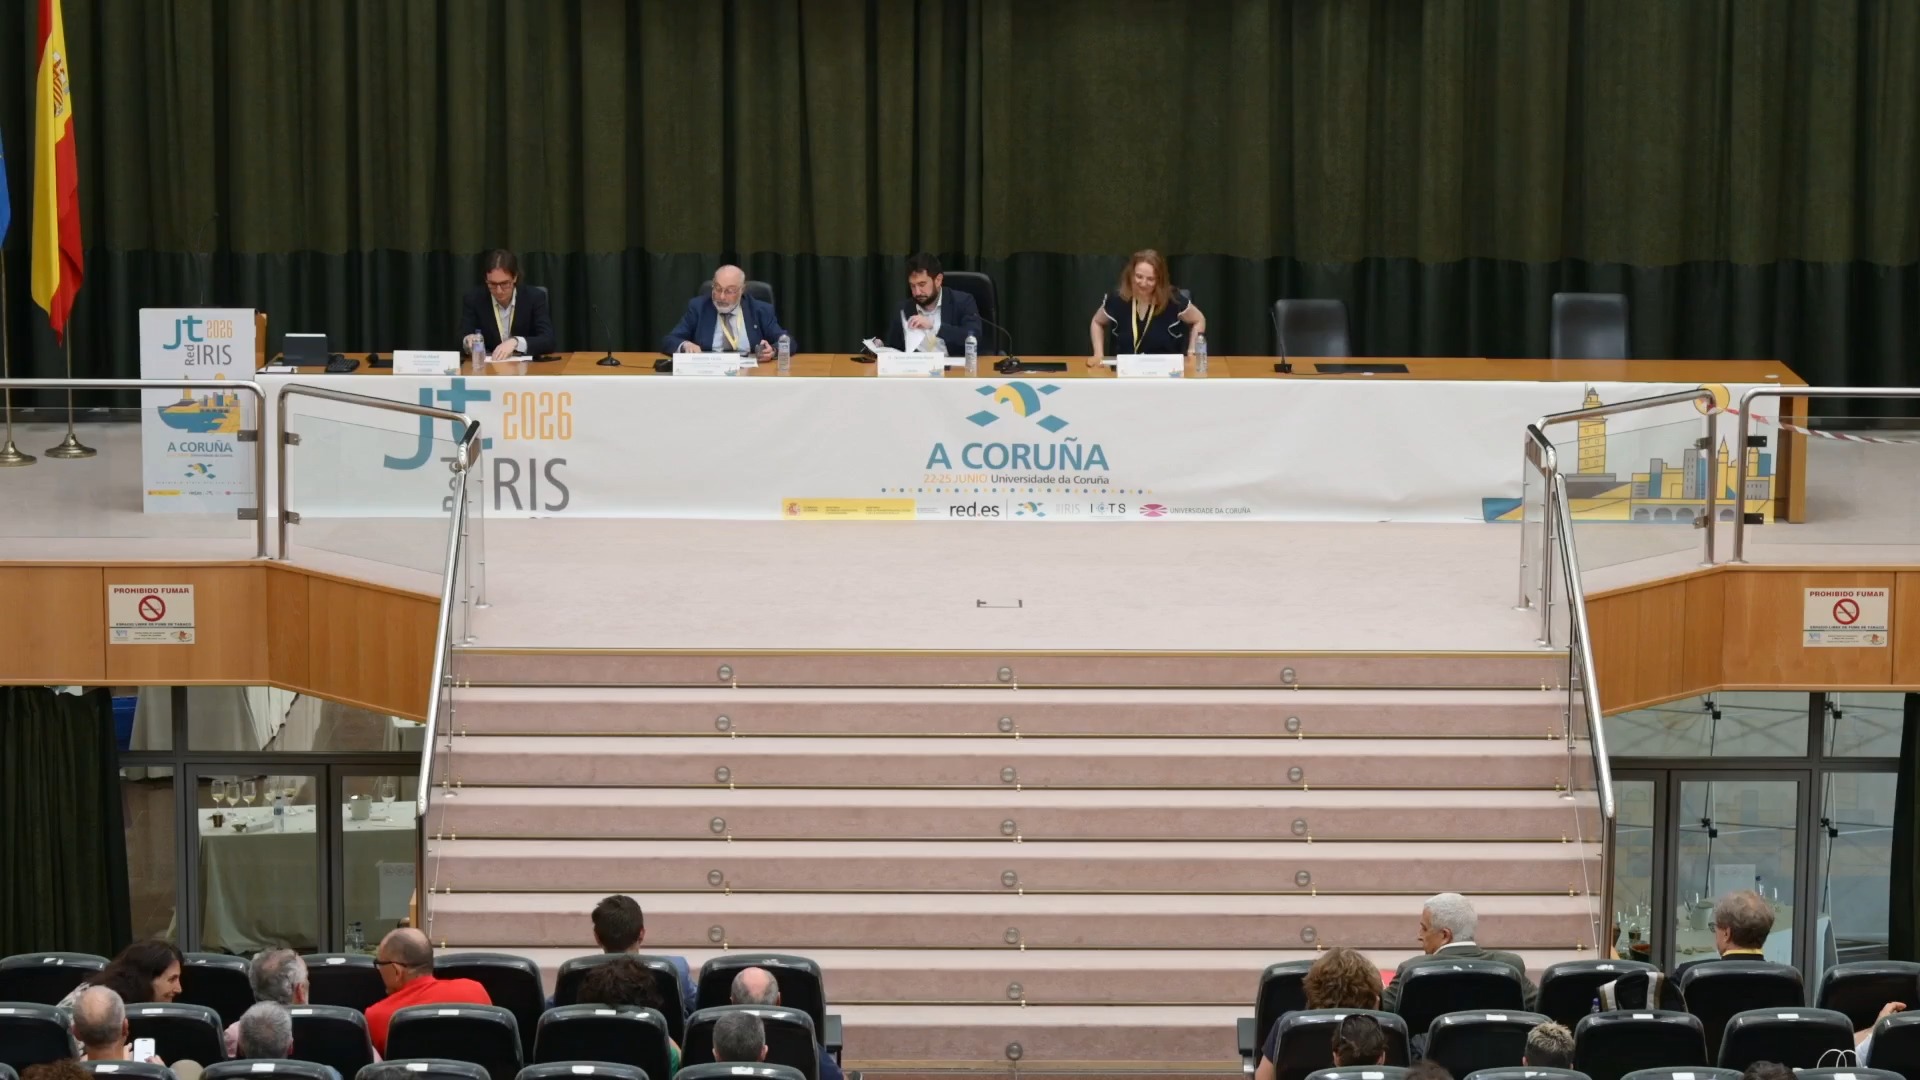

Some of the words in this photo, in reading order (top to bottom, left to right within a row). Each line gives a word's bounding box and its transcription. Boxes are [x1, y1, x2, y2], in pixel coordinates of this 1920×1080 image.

[206, 319, 233, 338] 2026
[184, 344, 195, 366] Red
[197, 344, 232, 366] IRIS
[502, 391, 573, 441] 2026
[167, 441, 177, 453] A
[179, 439, 233, 453] CORUÑA
[925, 442, 952, 470] A
[961, 436, 1110, 471] CORUÑA
[493, 457, 570, 512] RIS
[923, 474, 952, 484] 22-25
[953, 474, 988, 484] JUNIO
[990, 474, 1056, 484] Universidade
[1058, 475, 1071, 485] da
[1073, 475, 1110, 485] Coruña
[949, 501, 1000, 518] red.es
[1225, 506, 1251, 515] CORUÑA
